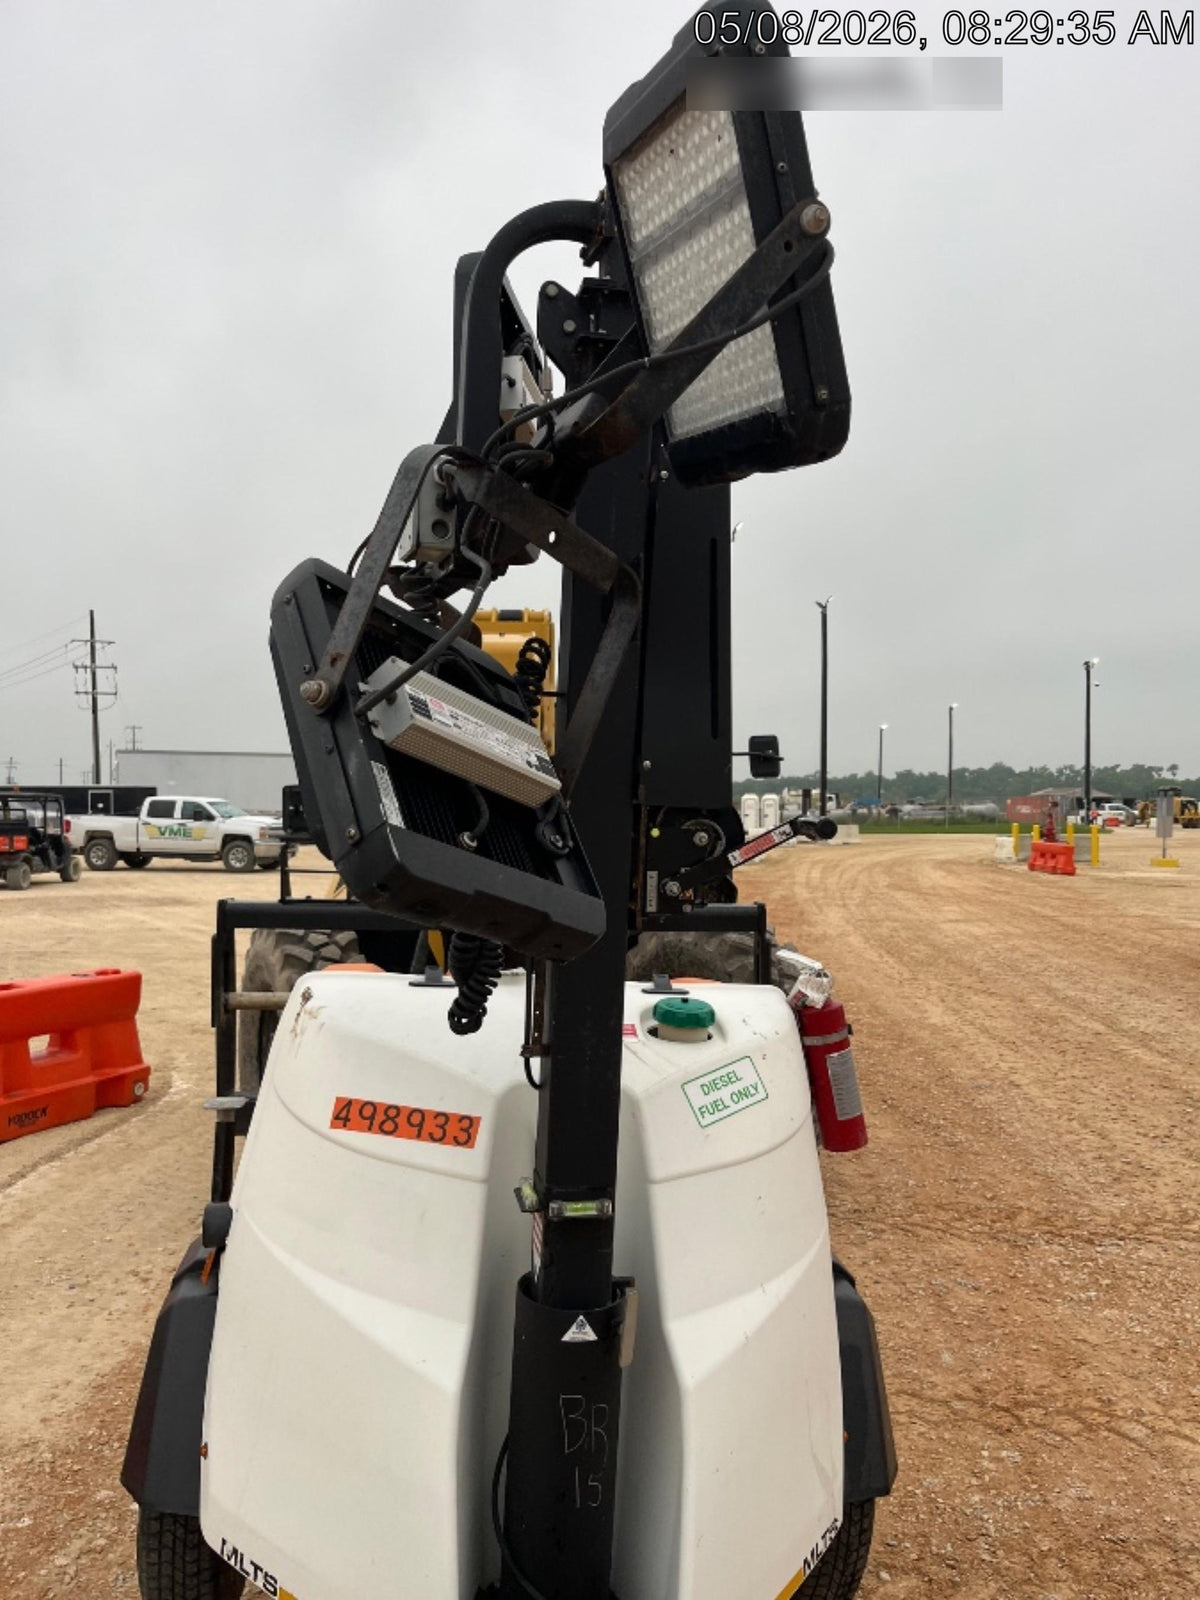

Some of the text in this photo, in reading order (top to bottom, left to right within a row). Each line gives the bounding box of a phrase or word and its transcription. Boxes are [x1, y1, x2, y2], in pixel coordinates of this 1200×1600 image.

[157, 825, 193, 838] VME
[698, 1082, 760, 1119] FUEL ONLY
[700, 1069, 743, 1096] DIESEL
[333, 1098, 475, 1147] 498933
[559, 1393, 609, 1465] BR
[220, 1536, 279, 1597] MLTS
